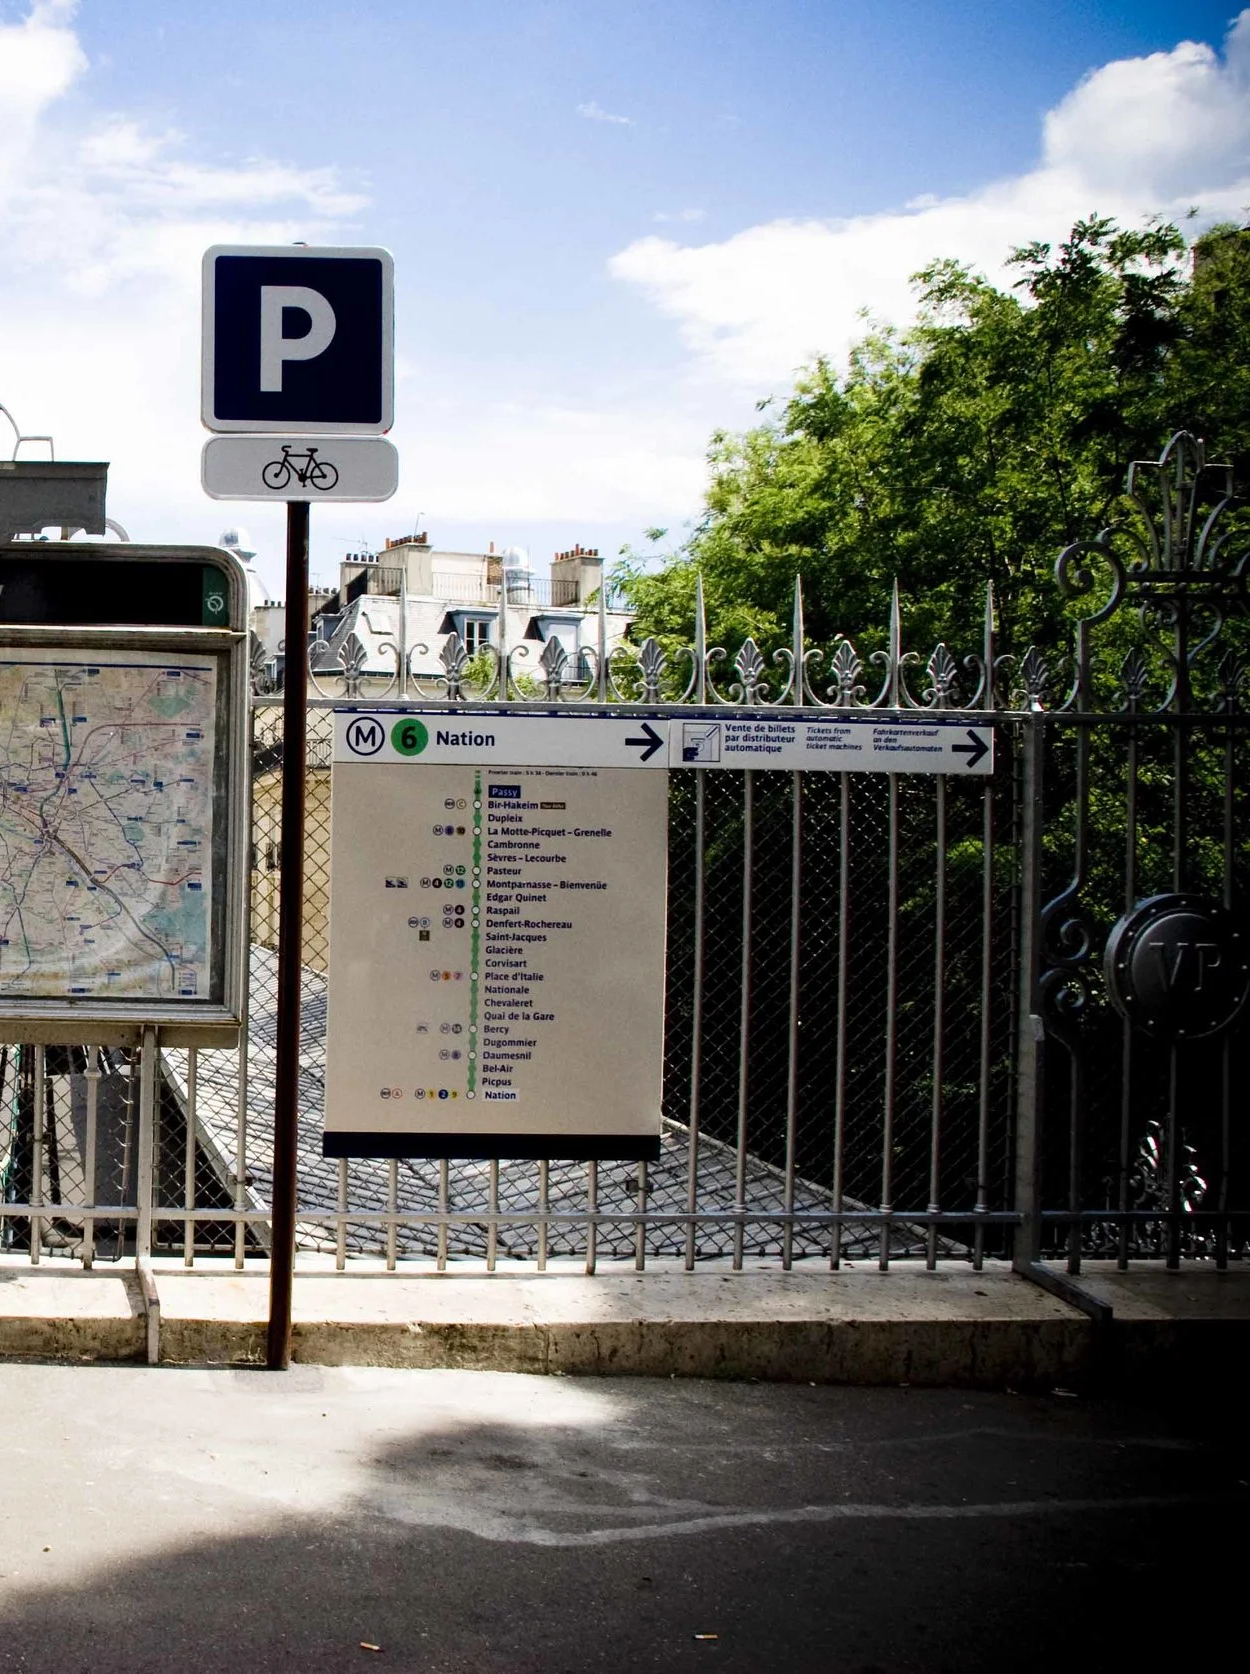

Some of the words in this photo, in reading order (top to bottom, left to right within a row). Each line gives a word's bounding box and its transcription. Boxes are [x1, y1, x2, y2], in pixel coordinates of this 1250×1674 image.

[260, 285, 336, 392] P
[725, 724, 751, 732] Vente
[754, 724, 766, 732] de
[768, 724, 796, 733] billets
[807, 726, 832, 734] Tickets
[834, 727, 851, 735] from
[355, 725, 376, 747] M
[401, 726, 417, 749] 6
[436, 730, 495, 747] Nation
[725, 734, 740, 744] par
[742, 734, 796, 743] distributeur
[724, 743, 782, 754] automatique
[829, 743, 862, 751] machines
[492, 787, 517, 797] Passy
[488, 800, 538, 810] Bir-Hakeim
[488, 814, 523, 824] Dupleix
[488, 827, 498, 836] La
[500, 827, 567, 838] Motte-Picquet
[574, 828, 613, 838] Grenelle
[488, 840, 541, 850] Cambronne
[487, 853, 517, 863] Sèvres
[525, 853, 567, 863] Lecourbe
[487, 866, 522, 876] Pasteur
[487, 880, 552, 890] Montparnasse
[559, 880, 608, 890] Bienvenüe
[487, 893, 513, 903] Edgar
[515, 893, 547, 904] Quinet
[487, 906, 520, 916] Raspail
[486, 919, 573, 929] Denfert-Rochereau
[486, 932, 548, 943] Saint-Jacques
[486, 945, 523, 955] Glacière
[485, 958, 527, 968] Corvisart
[1149, 942, 1222, 992] VP
[485, 972, 509, 981] Place
[485, 985, 530, 995] Nationale
[484, 998, 533, 1008] Chevaleret
[484, 1011, 506, 1021] Quai
[508, 1011, 519, 1021] de
[520, 1011, 529, 1021] la
[532, 1011, 555, 1021] Gare
[484, 1025, 510, 1035] Bercy
[483, 1038, 537, 1049] Dugommier
[483, 1051, 532, 1060] Daumesnil
[483, 1063, 514, 1073] Bel-Air
[482, 1077, 512, 1087] Picpus
[484, 1090, 517, 1100] Nation
